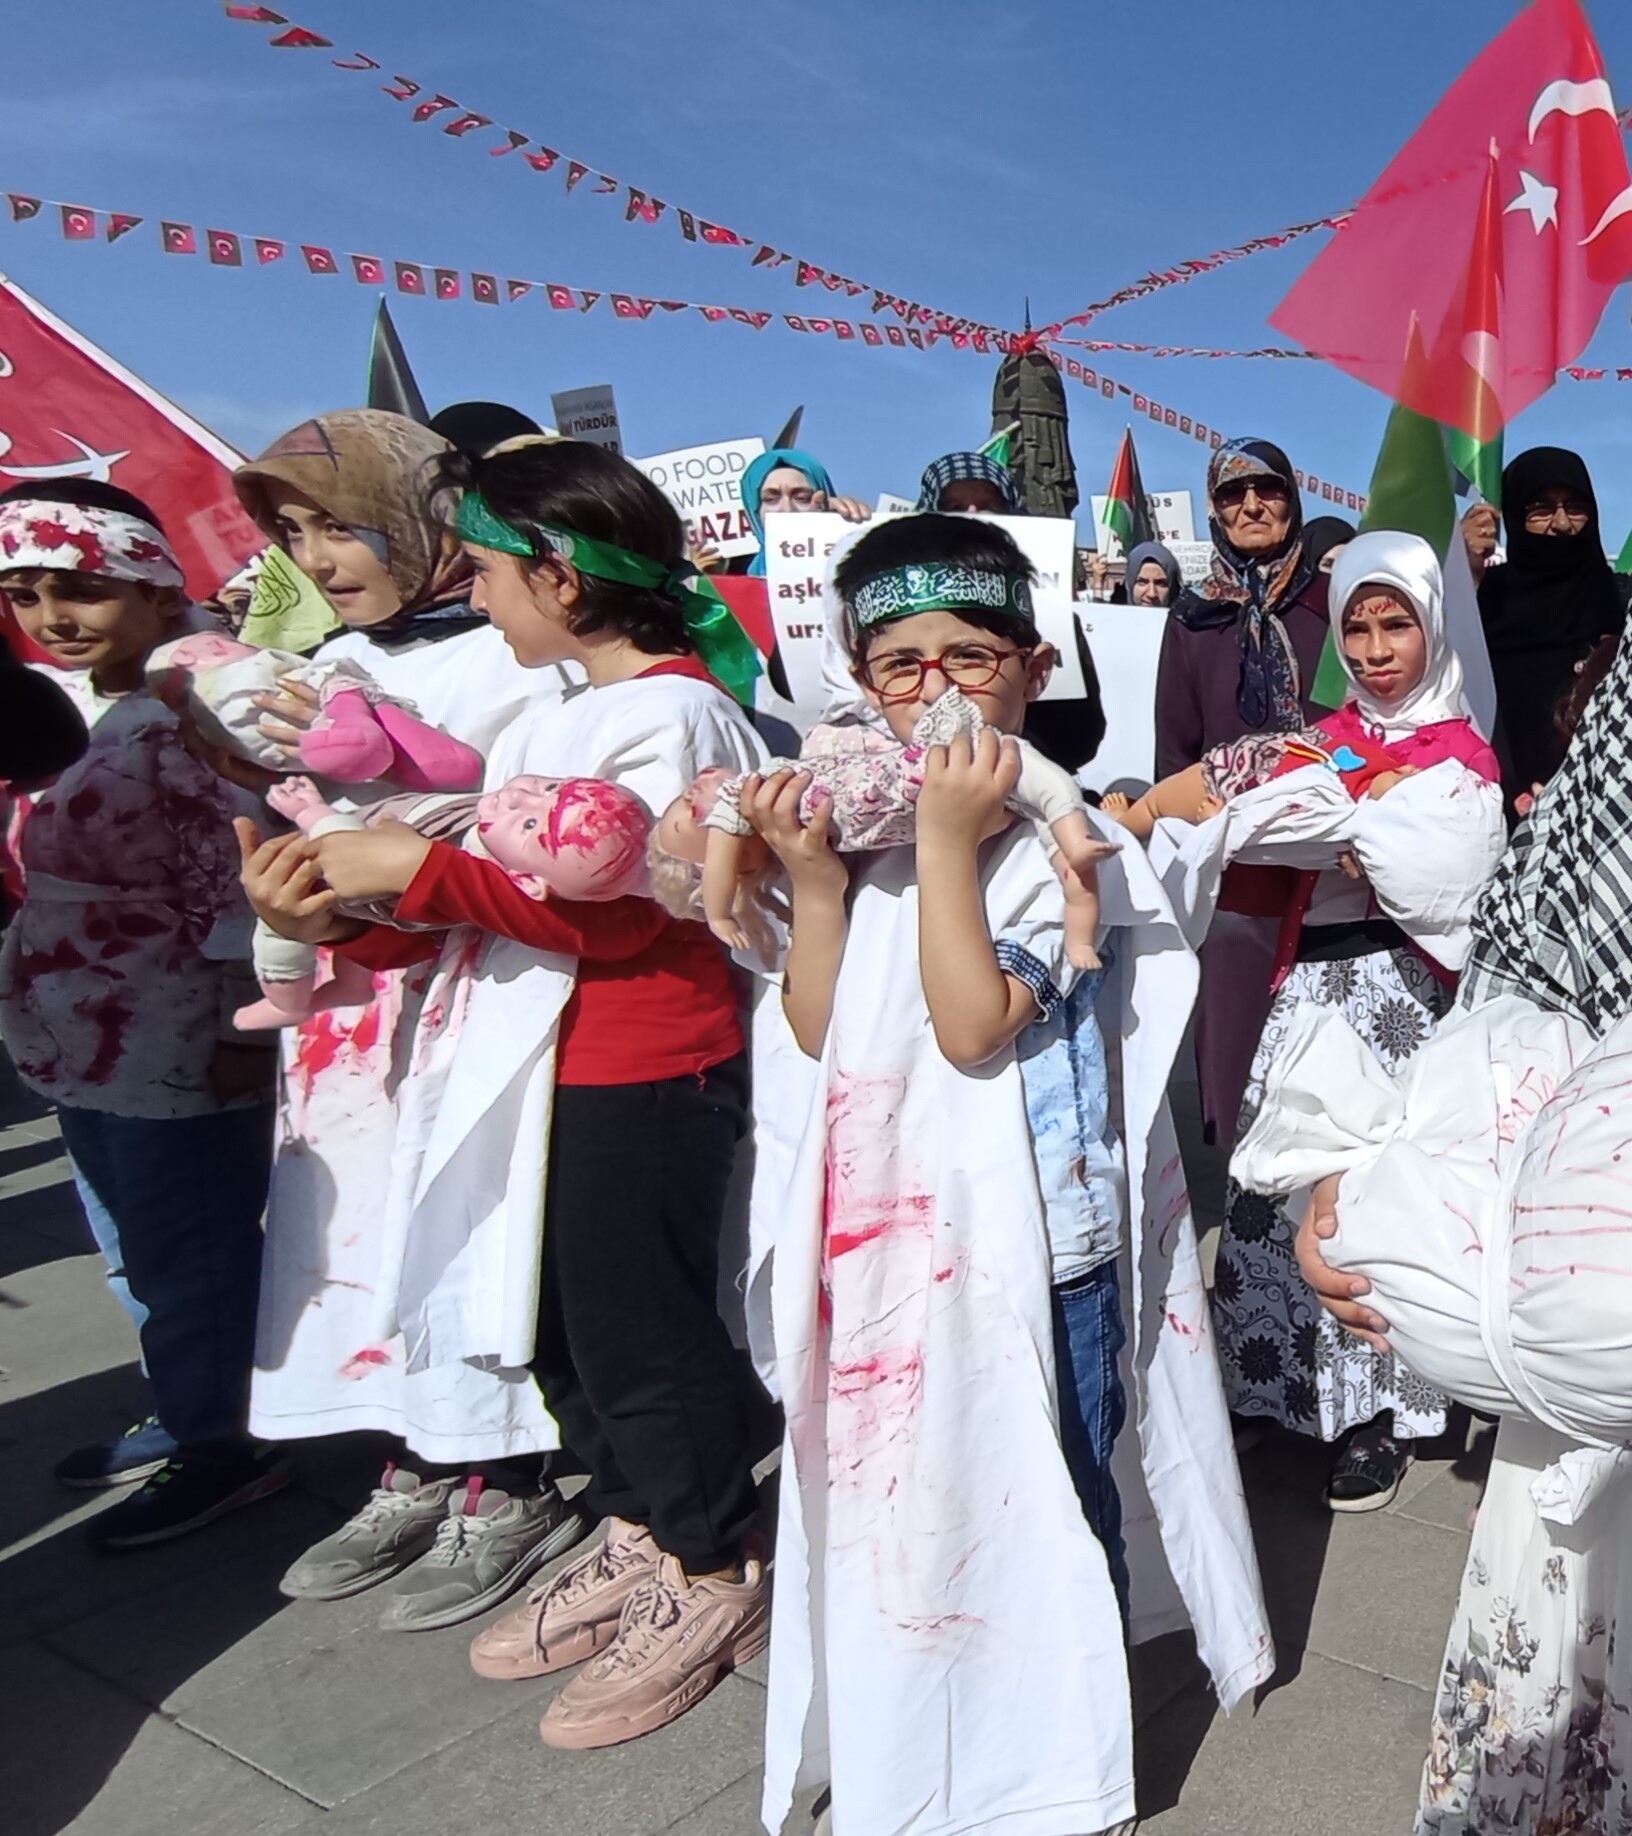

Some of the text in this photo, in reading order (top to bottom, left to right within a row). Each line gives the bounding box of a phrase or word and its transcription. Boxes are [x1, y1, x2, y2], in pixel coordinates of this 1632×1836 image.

[672, 452, 746, 483] FOOD
[672, 479, 742, 510] WATE
[682, 508, 757, 546] GAZA
[779, 537, 815, 558] tel
[786, 623, 823, 639] urs
